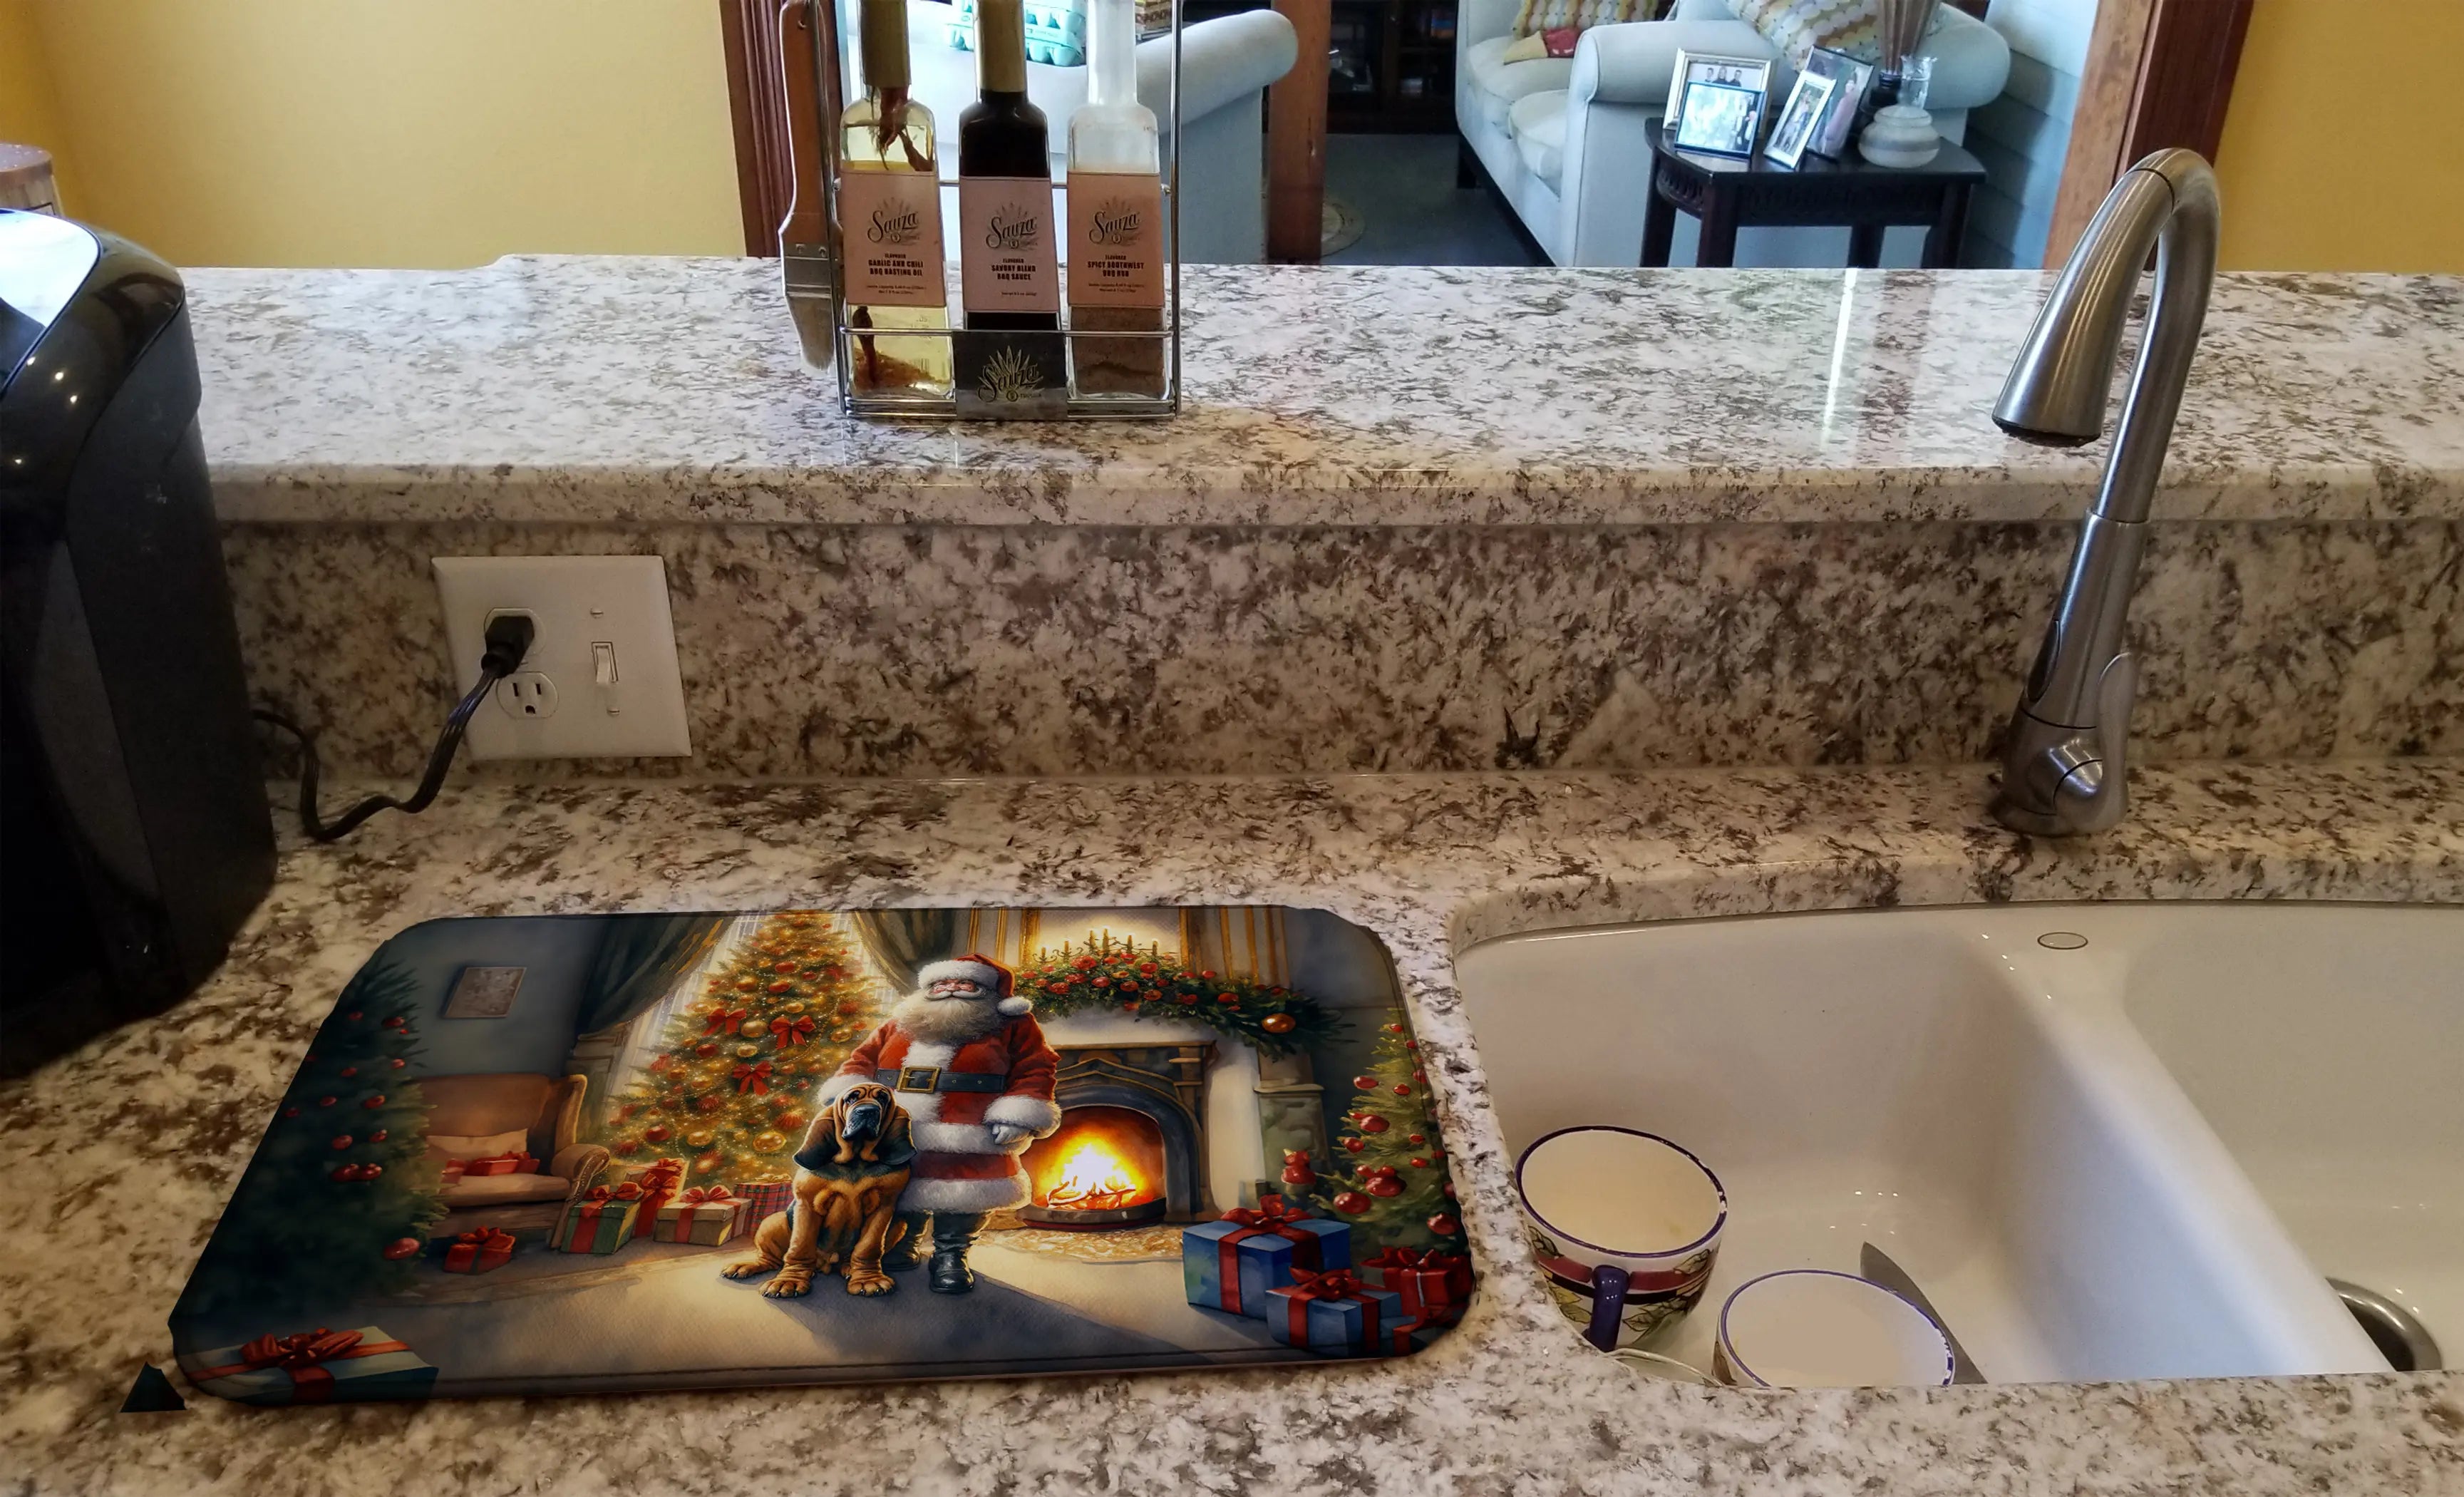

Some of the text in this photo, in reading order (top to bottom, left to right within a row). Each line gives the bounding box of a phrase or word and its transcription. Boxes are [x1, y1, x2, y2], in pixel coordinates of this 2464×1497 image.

[867, 210, 919, 243] Sauza
[986, 216, 1036, 249] Sauza
[1089, 211, 1139, 244] Sauza
[977, 364, 1039, 403] Sauza
